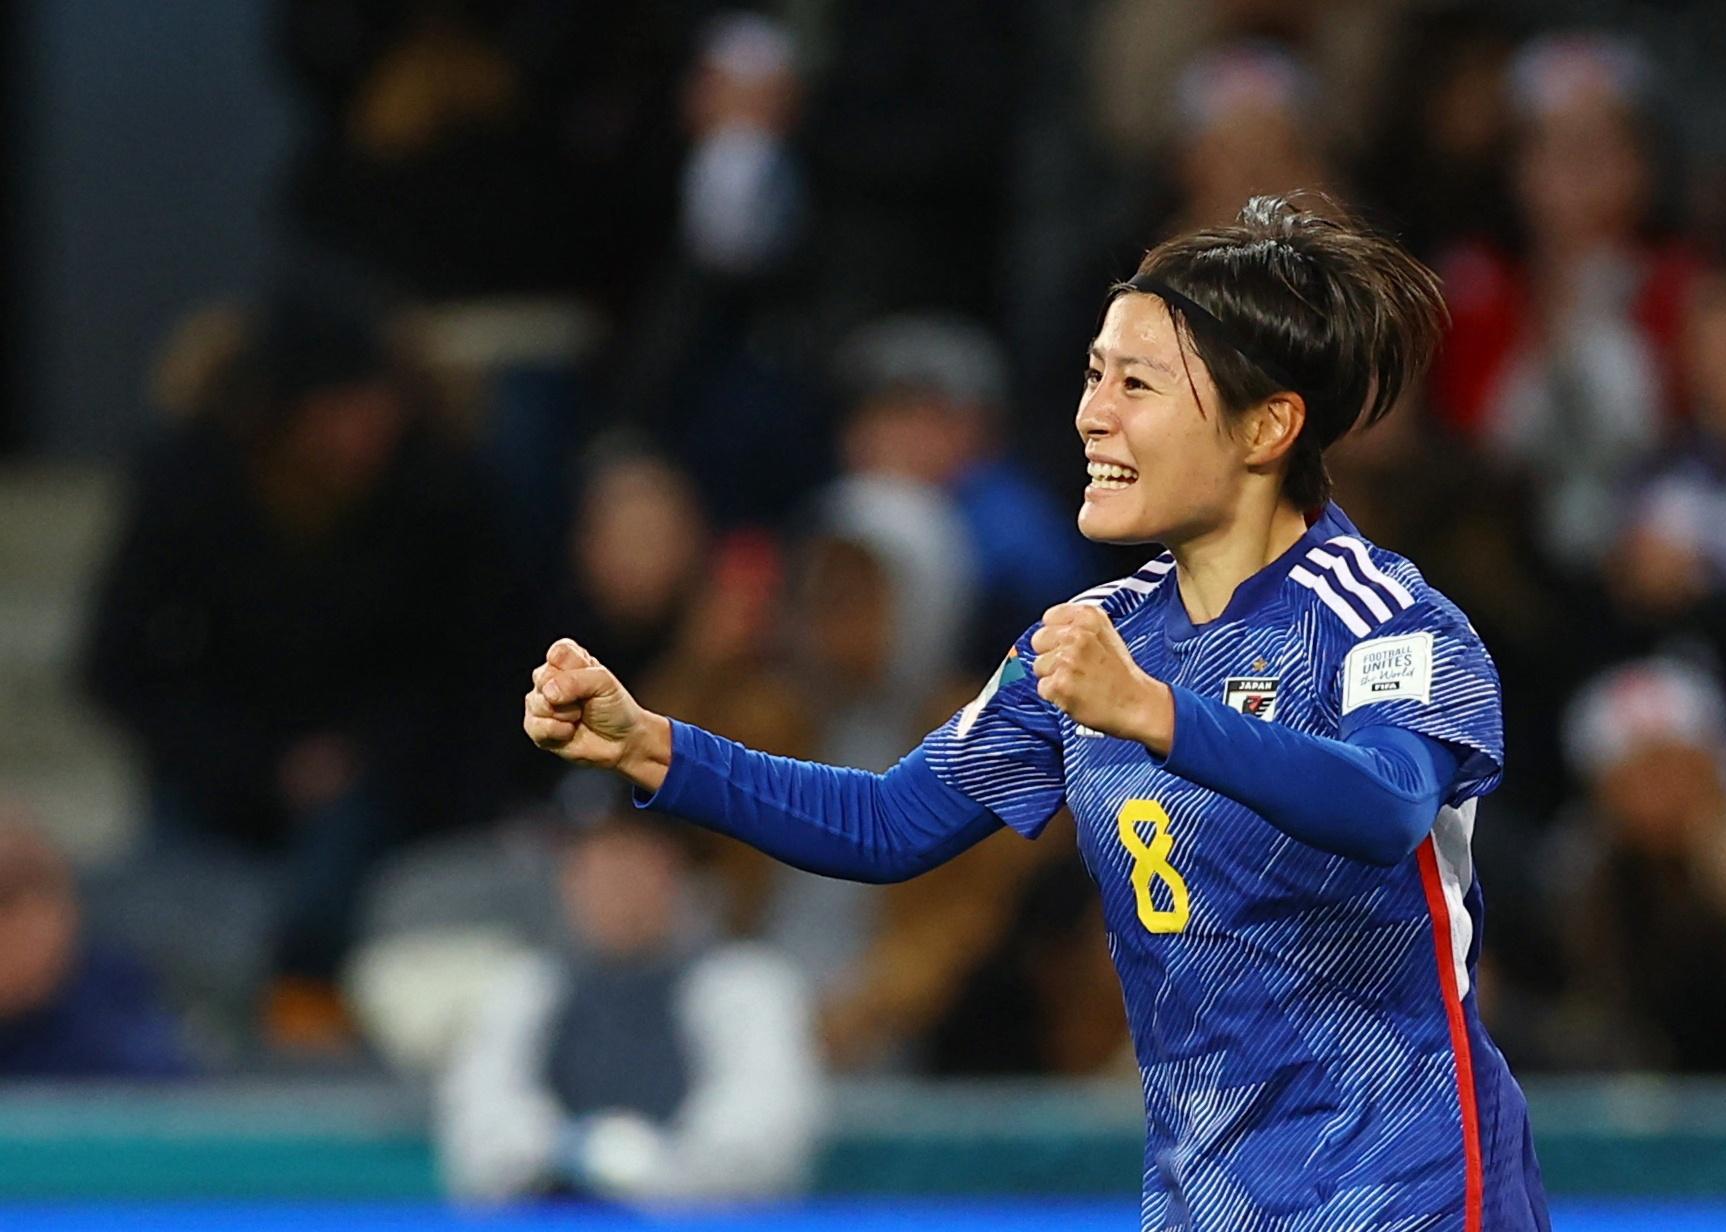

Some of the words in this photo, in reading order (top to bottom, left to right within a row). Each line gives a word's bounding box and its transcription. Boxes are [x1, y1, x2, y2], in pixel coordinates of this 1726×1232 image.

[1363, 645, 1413, 662] FOOTBALL
[1363, 654, 1412, 674] UNITES
[1380, 667, 1415, 680] World
[1238, 681, 1273, 690] JAPAN
[1373, 682, 1398, 691] FIFA
[1118, 799, 1189, 934] 8
